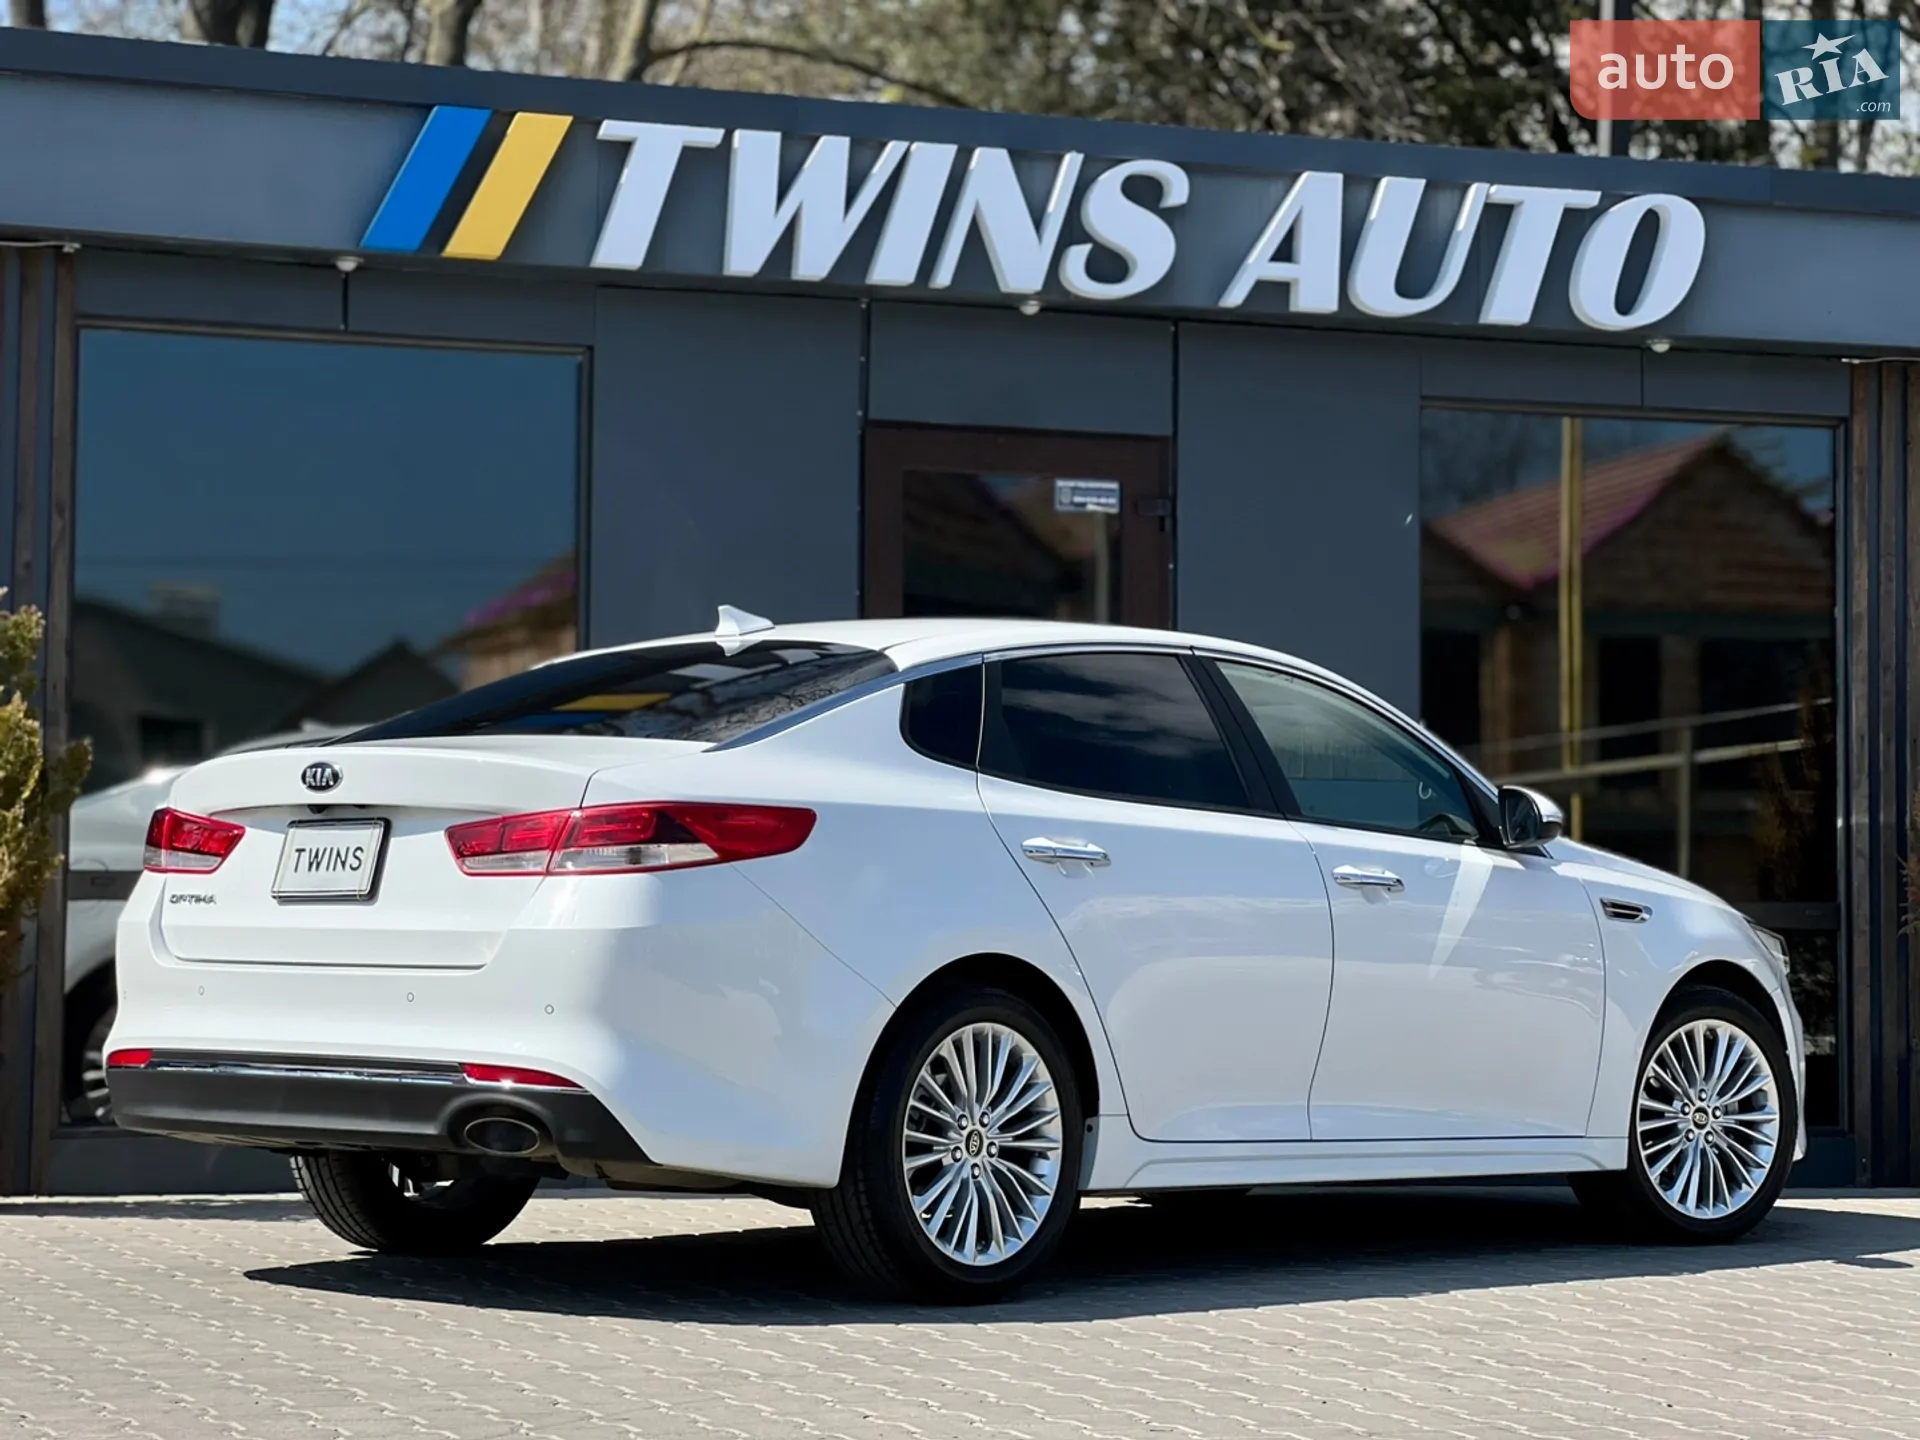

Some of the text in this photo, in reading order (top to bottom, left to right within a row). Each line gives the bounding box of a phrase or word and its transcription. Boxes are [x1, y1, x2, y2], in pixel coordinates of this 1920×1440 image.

[589, 119, 1705, 331] TWINS AUTO
[305, 767, 334, 786] KIA
[294, 846, 365, 873] TWINS
